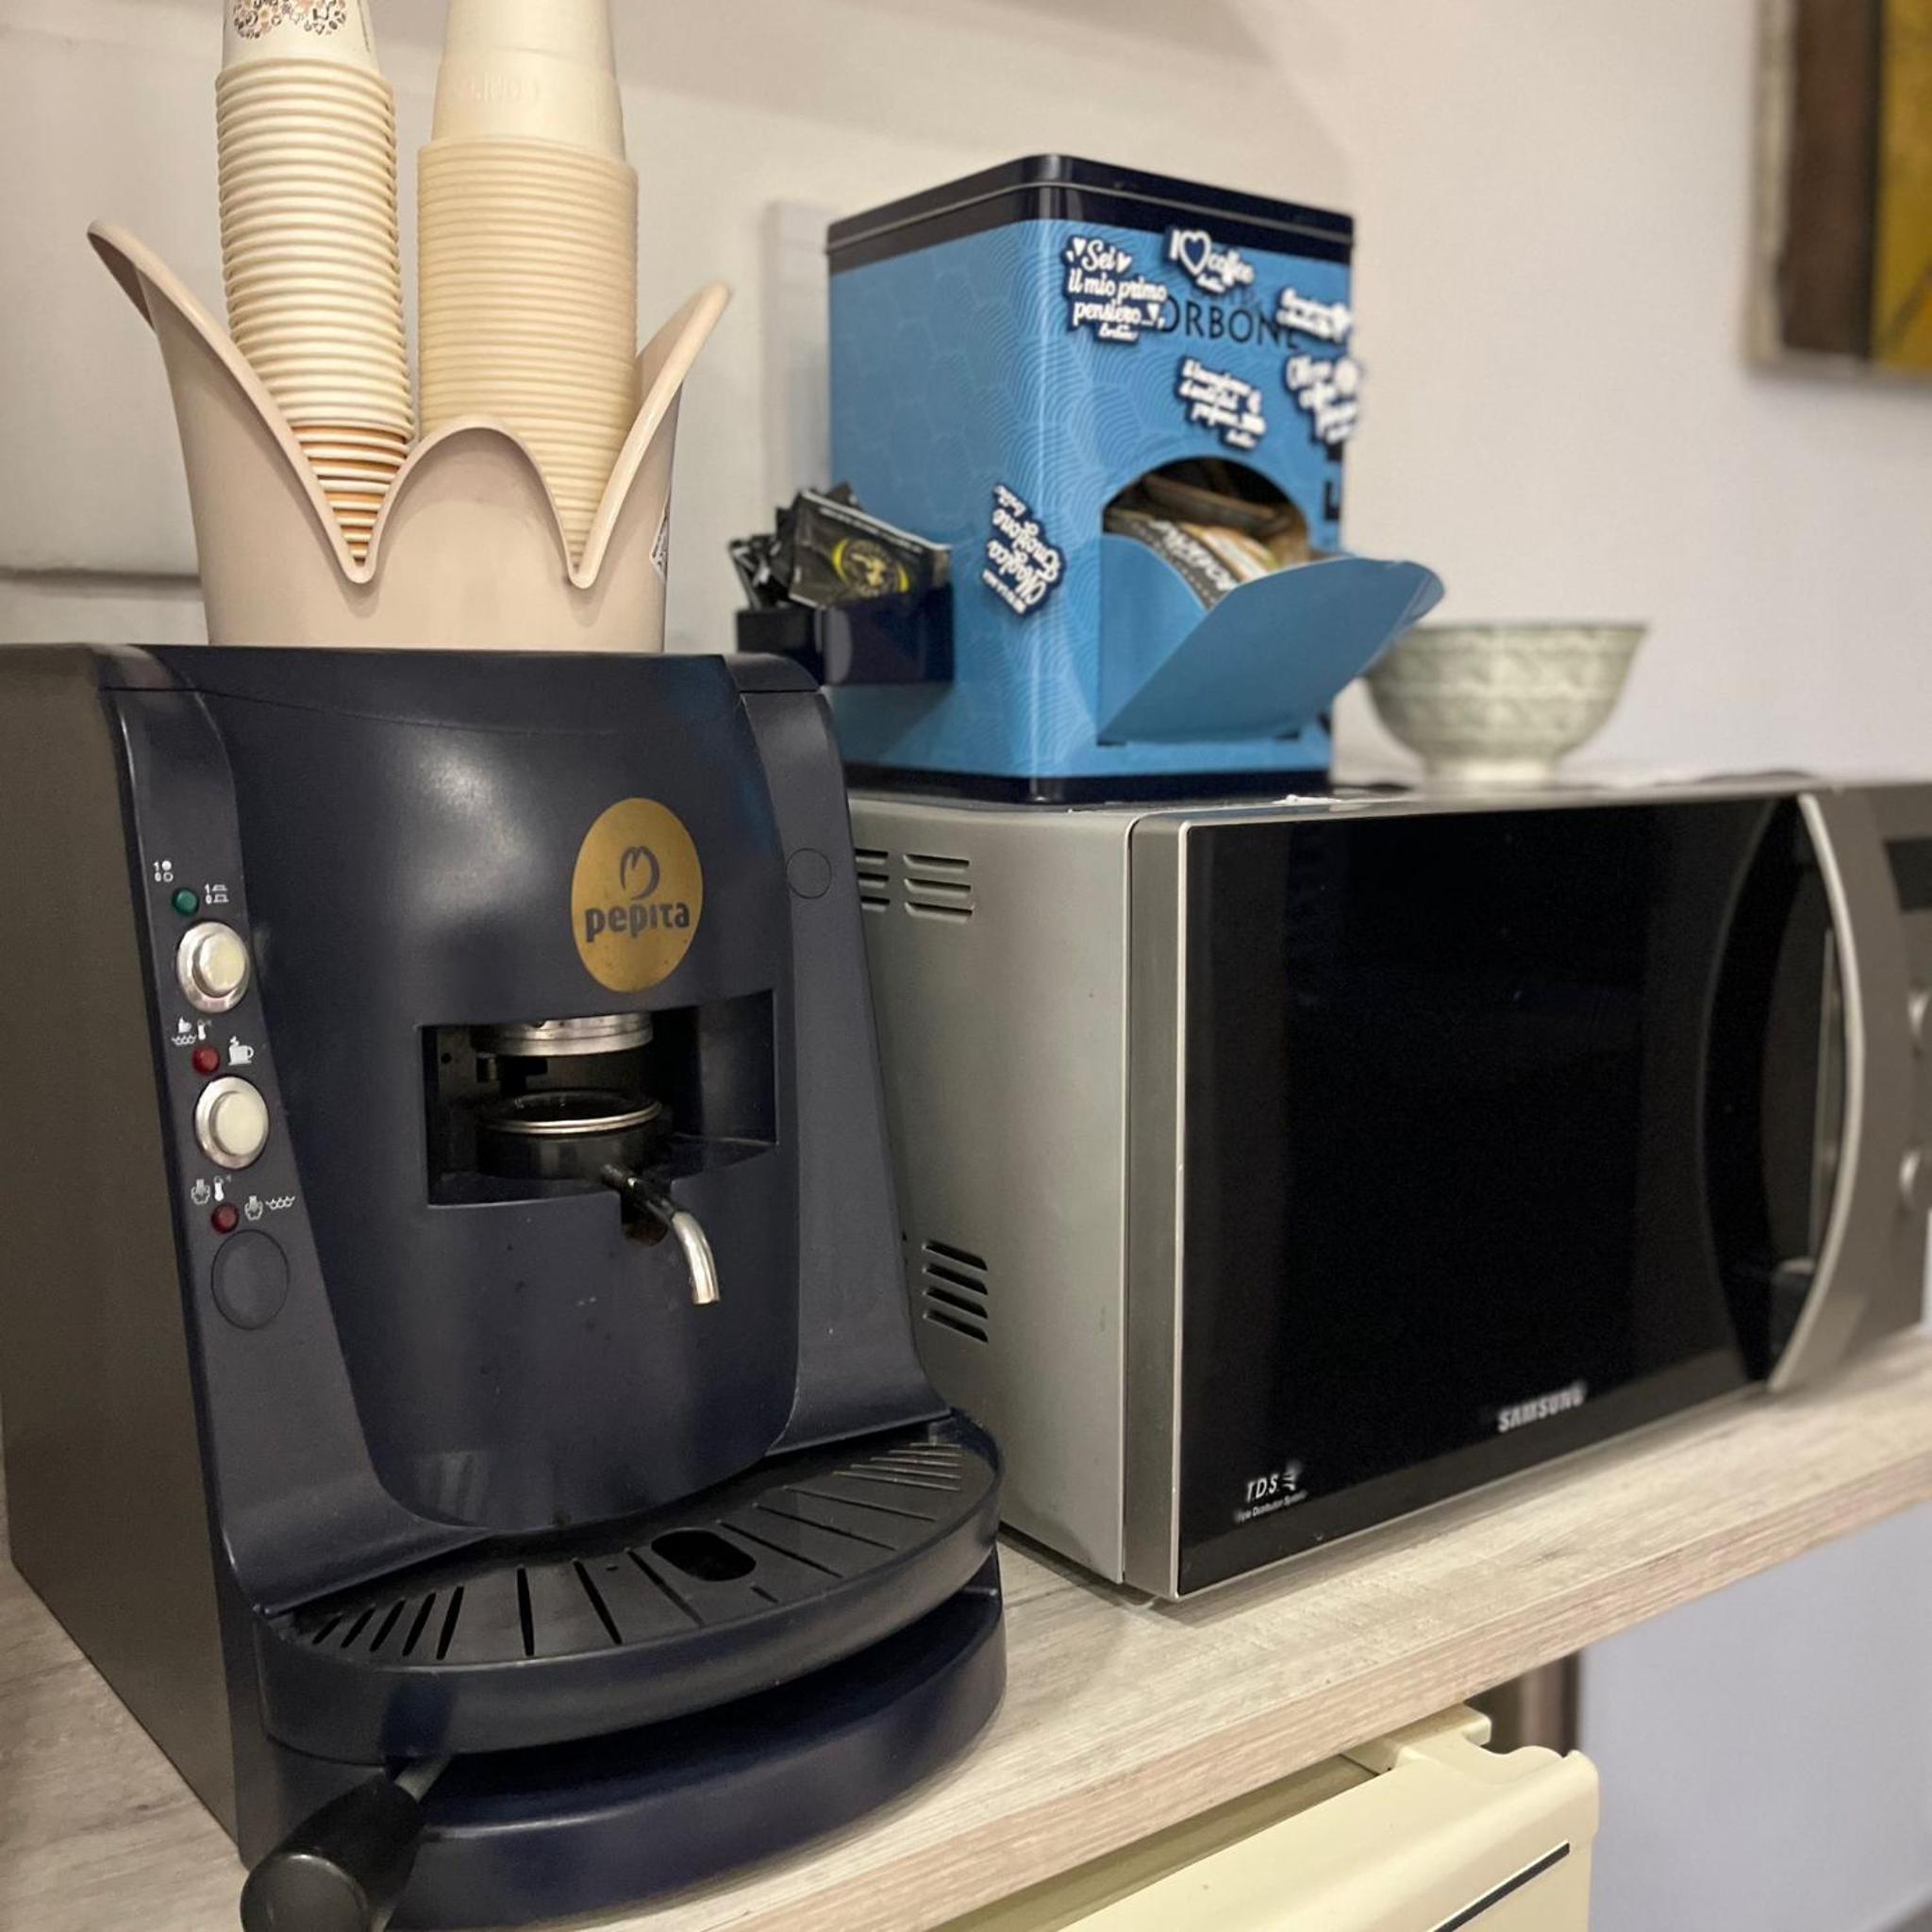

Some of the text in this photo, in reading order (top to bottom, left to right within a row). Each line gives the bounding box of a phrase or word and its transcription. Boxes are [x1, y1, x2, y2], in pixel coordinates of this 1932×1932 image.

[1081, 240, 1116, 272] Sei
[1084, 272, 1116, 297] mio
[1117, 275, 1167, 306] primo
[1162, 293, 1298, 350] ORBON
[585, 902, 690, 943] pepita
[1498, 1383, 1587, 1433] SAMSUNG
